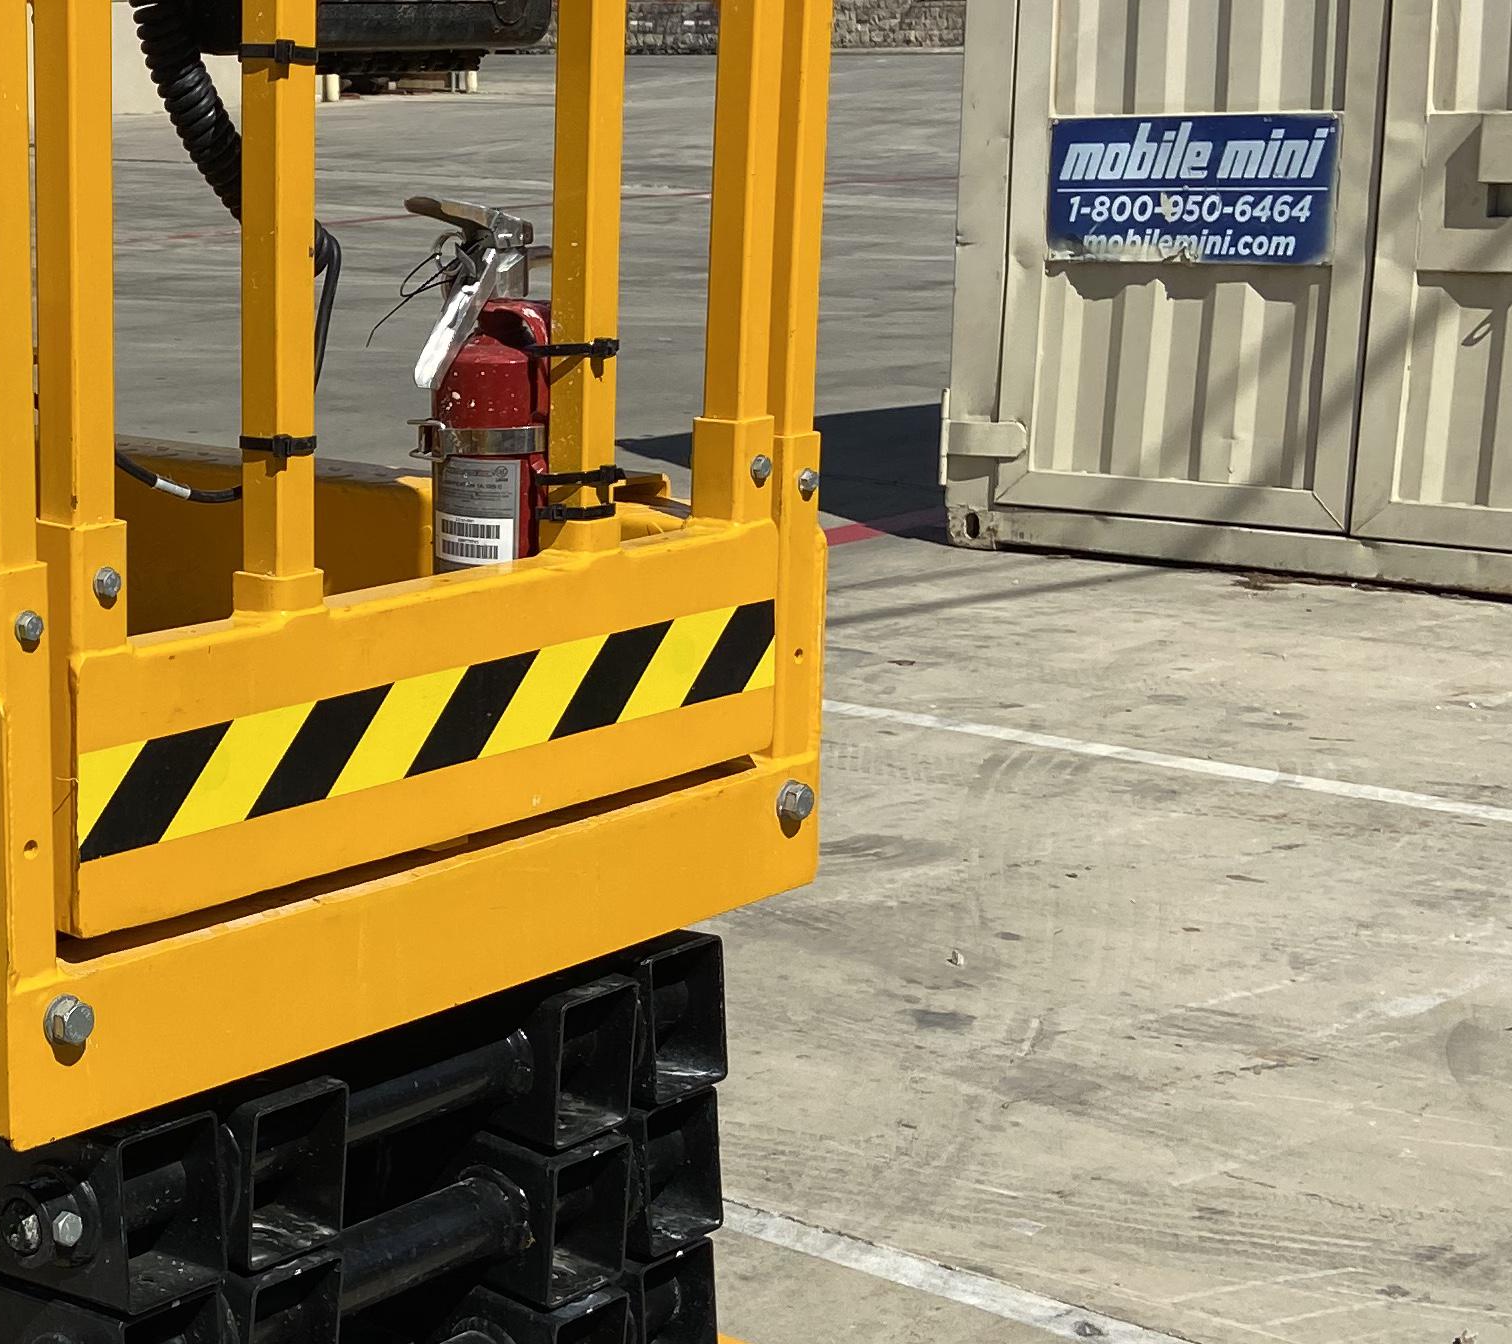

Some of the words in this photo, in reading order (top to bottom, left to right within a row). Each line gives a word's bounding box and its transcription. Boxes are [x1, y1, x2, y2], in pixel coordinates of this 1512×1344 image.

[1059, 121, 1213, 181] mobile
[1216, 128, 1329, 179] mini
[1068, 194, 1313, 224] 1-800-950-6464
